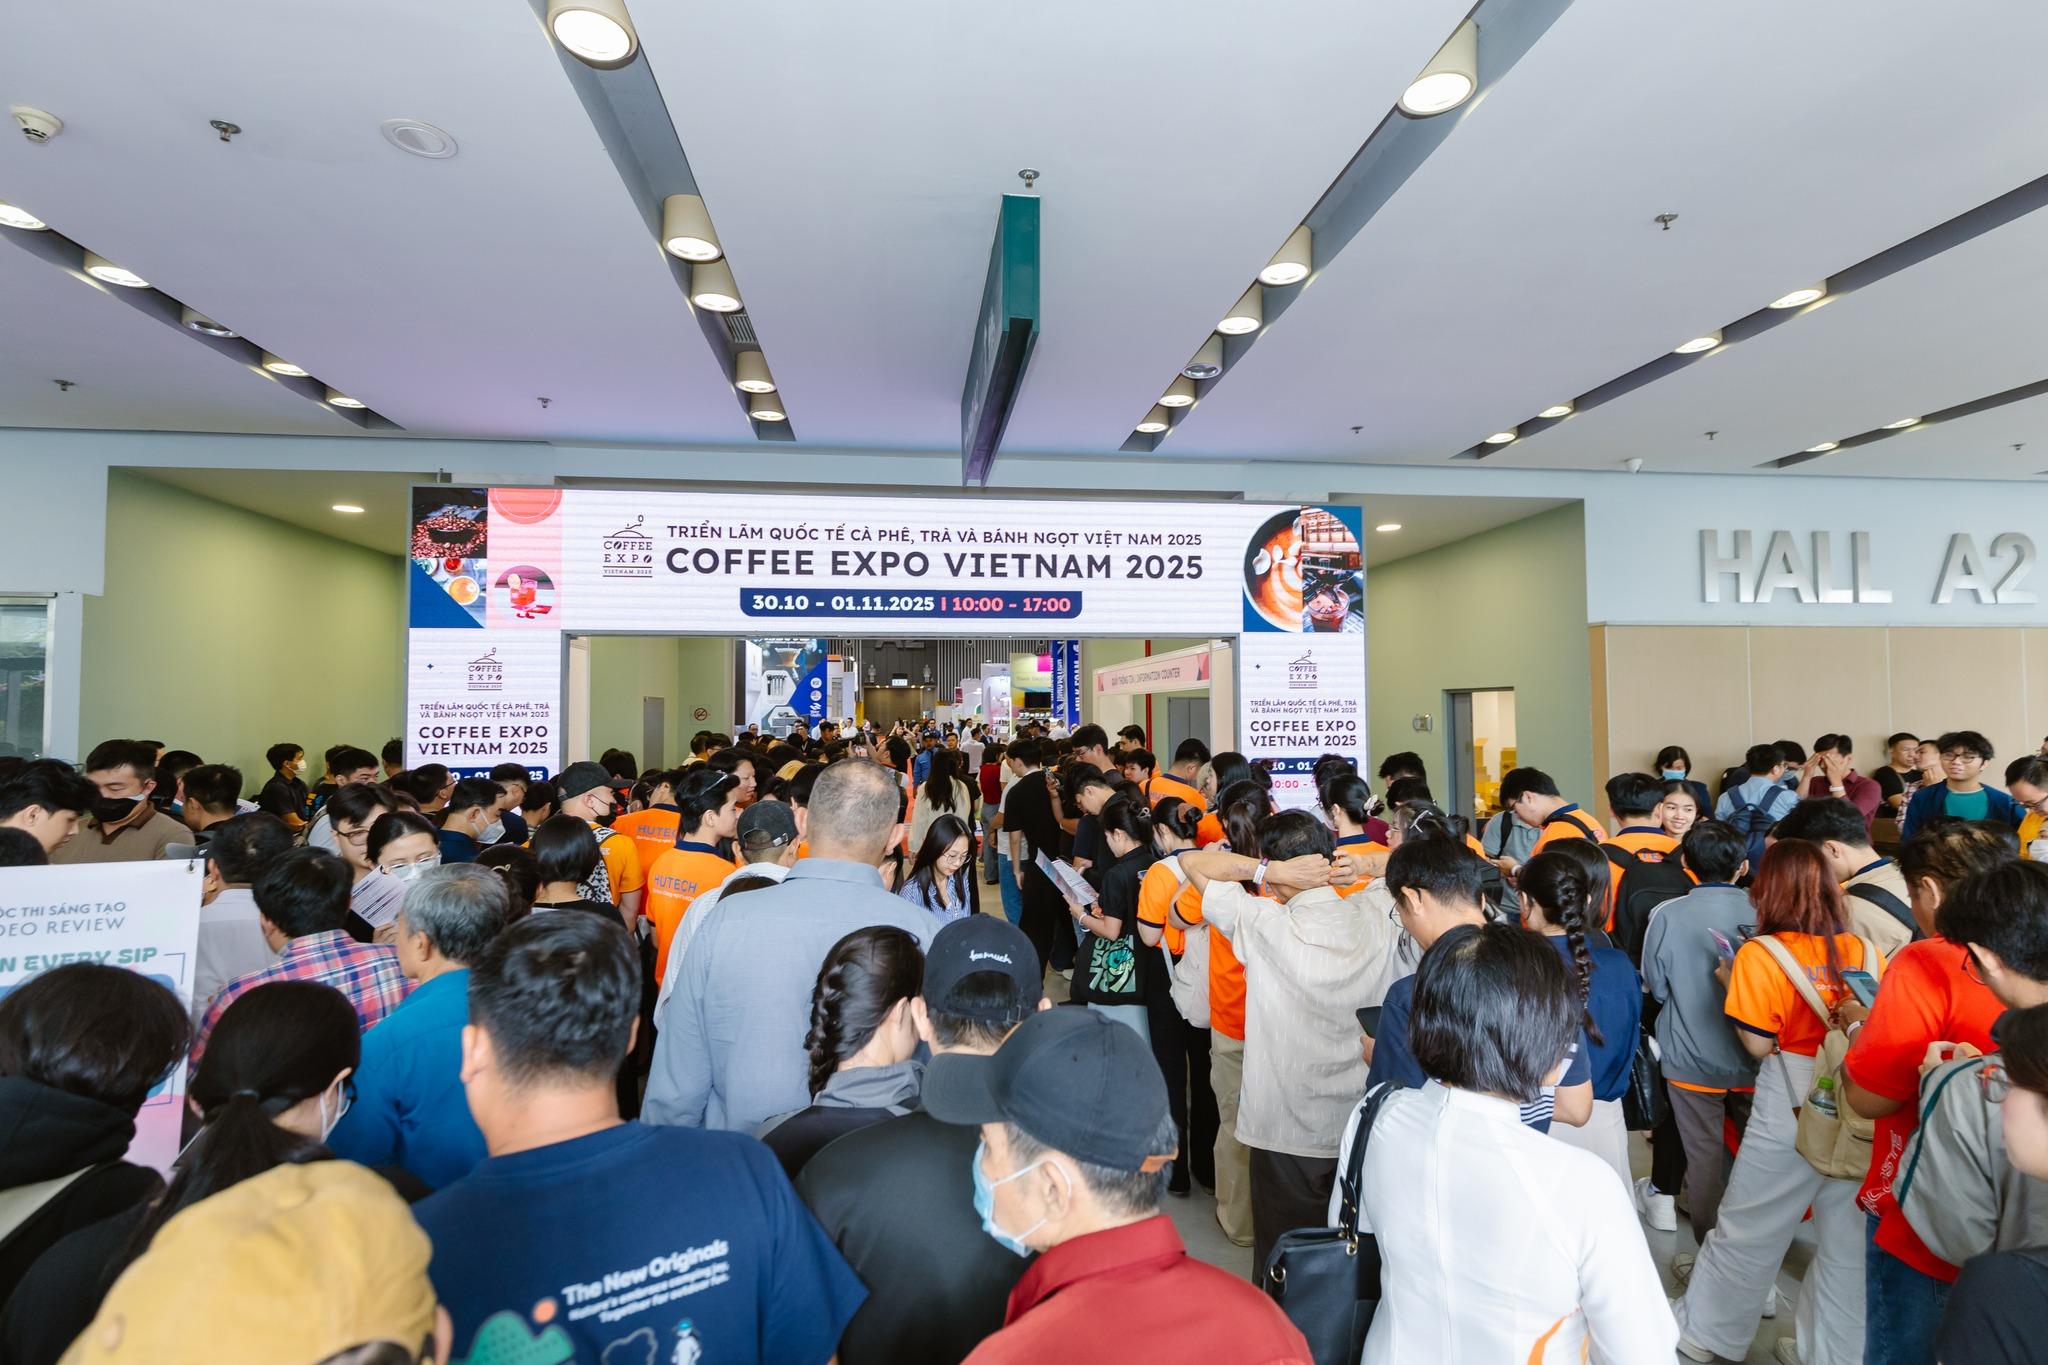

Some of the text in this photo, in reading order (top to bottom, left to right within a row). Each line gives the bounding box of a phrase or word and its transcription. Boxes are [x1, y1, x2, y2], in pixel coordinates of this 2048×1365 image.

[667, 520, 1202, 548] TRIỂN LÃM QUỐC TẾ CÀ PHÊ, TRÀ VÀ BÁNH NGỌT VIỆT NAM 2025
[666, 547, 1203, 579] COFFEE EXPO VIETNAM 2025
[1698, 529, 2039, 604] HALL A2
[752, 595, 809, 611] 30.10
[831, 595, 935, 611] 01.11.2025
[952, 596, 1004, 612] 10:00
[1022, 597, 1072, 612] 17:00
[510, 711, 528, 719] NAM
[531, 711, 550, 719] 2025
[418, 725, 549, 739] COFFEE EXPO
[1250, 720, 1357, 732] COFFEE EXPO
[418, 741, 549, 755] VIETNAM 2025
[1250, 735, 1357, 747] VIETNAM 2025
[1274, 780, 1299, 789] 0:00
[21, 905, 45, 917] THI
[48, 902, 91, 916] SÁNG
[95, 901, 126, 915] TẠO
[46, 916, 126, 935] REVIEW
[117, 946, 158, 964] SIP
[561, 1238, 730, 1306] The New Originals
